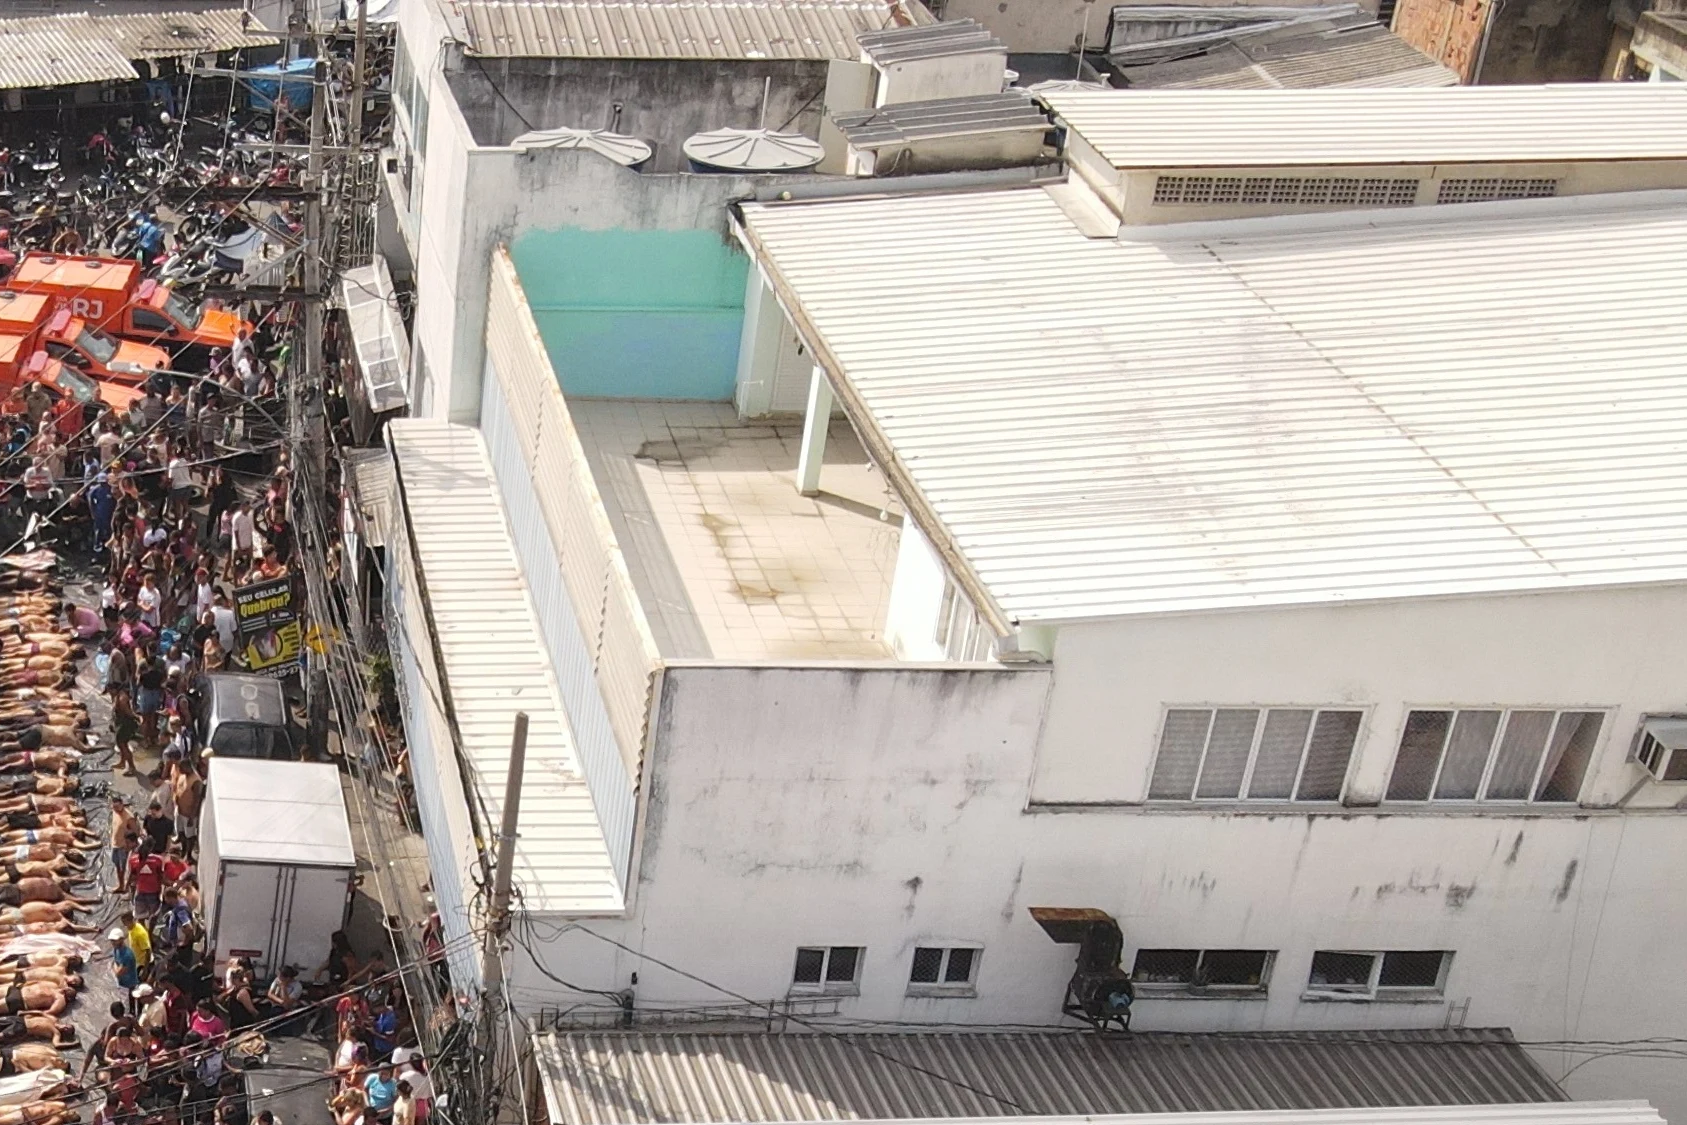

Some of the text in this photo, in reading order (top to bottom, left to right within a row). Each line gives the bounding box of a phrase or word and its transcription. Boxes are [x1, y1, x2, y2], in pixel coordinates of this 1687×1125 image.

[72, 298, 103, 320] RJ
[238, 593, 253, 604] SEU
[240, 592, 291, 618] Quebrou?
